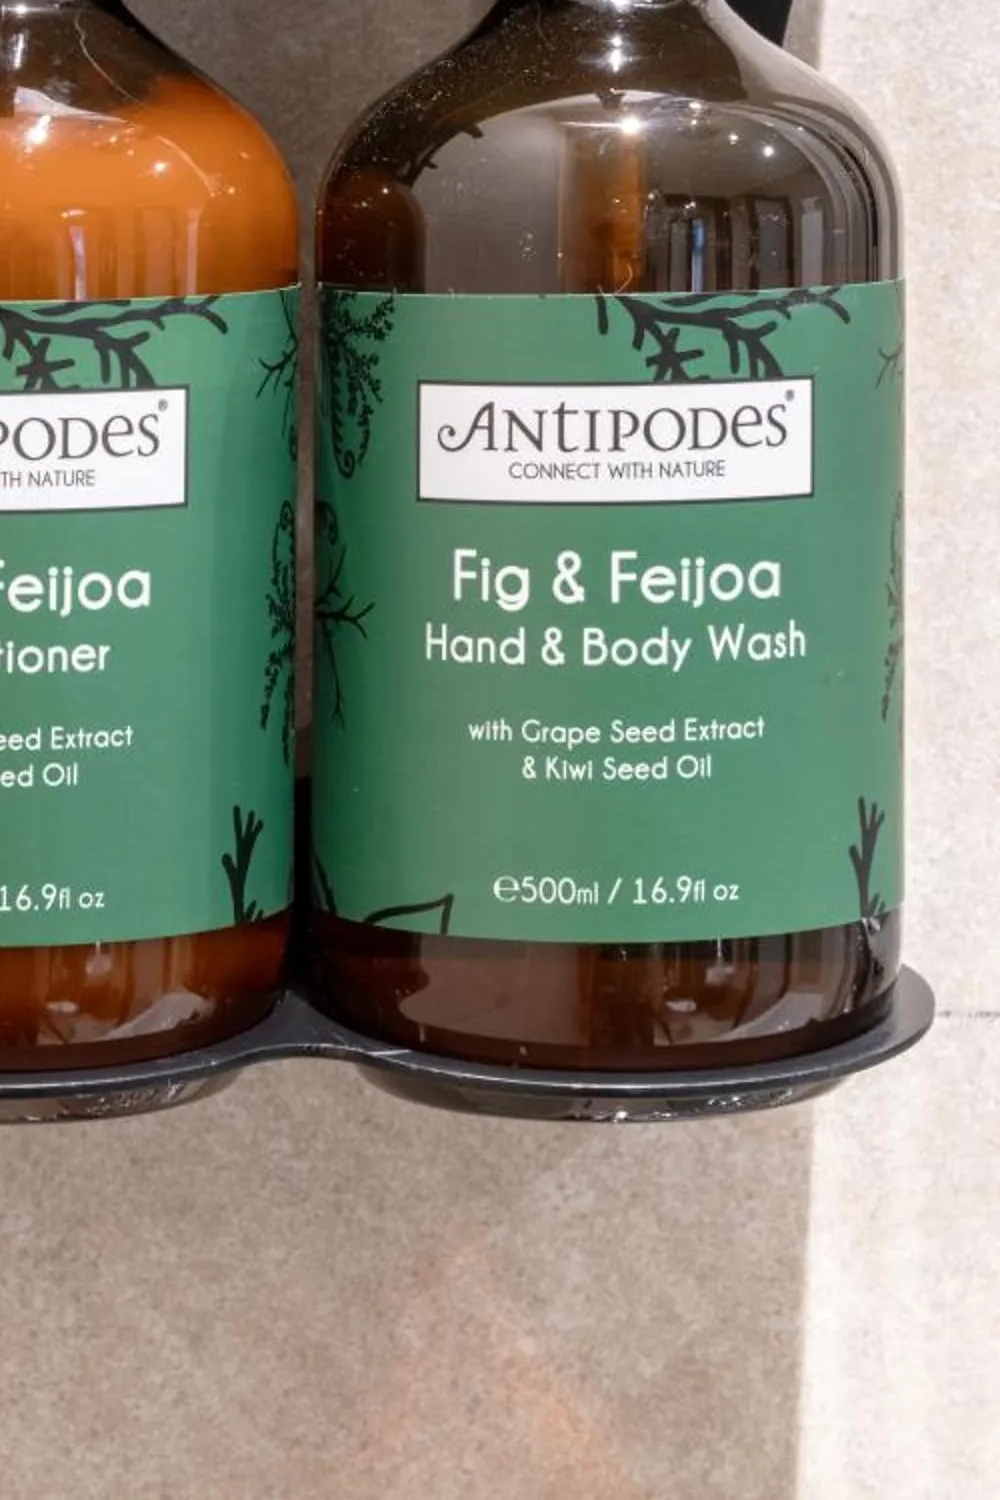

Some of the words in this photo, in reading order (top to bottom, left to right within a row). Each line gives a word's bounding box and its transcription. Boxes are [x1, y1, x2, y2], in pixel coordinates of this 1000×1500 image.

[27, 469, 96, 488] NATURE
[508, 461, 601, 481] CONNECT
[607, 461, 653, 480] WITH
[658, 459, 726, 479] NATURE
[453, 548, 530, 612] Fig
[551, 550, 585, 605] &
[610, 550, 781, 609] Feijoa
[426, 622, 526, 665] Hand
[541, 626, 565, 666] &
[582, 625, 693, 673] Body
[707, 618, 806, 661] Wash
[50, 725, 134, 750] Extract
[468, 717, 513, 741] with
[521, 718, 601, 751] Grape
[610, 718, 676, 744] Seed
[684, 716, 765, 742] Extract
[42, 762, 79, 787] Oil
[521, 755, 537, 779] &
[545, 755, 593, 781] Kiwi
[602, 755, 668, 781] Seed
[676, 753, 712, 779] Oil
[78, 891, 105, 909] oz
[607, 877, 623, 905] /
[712, 883, 740, 901] oz
